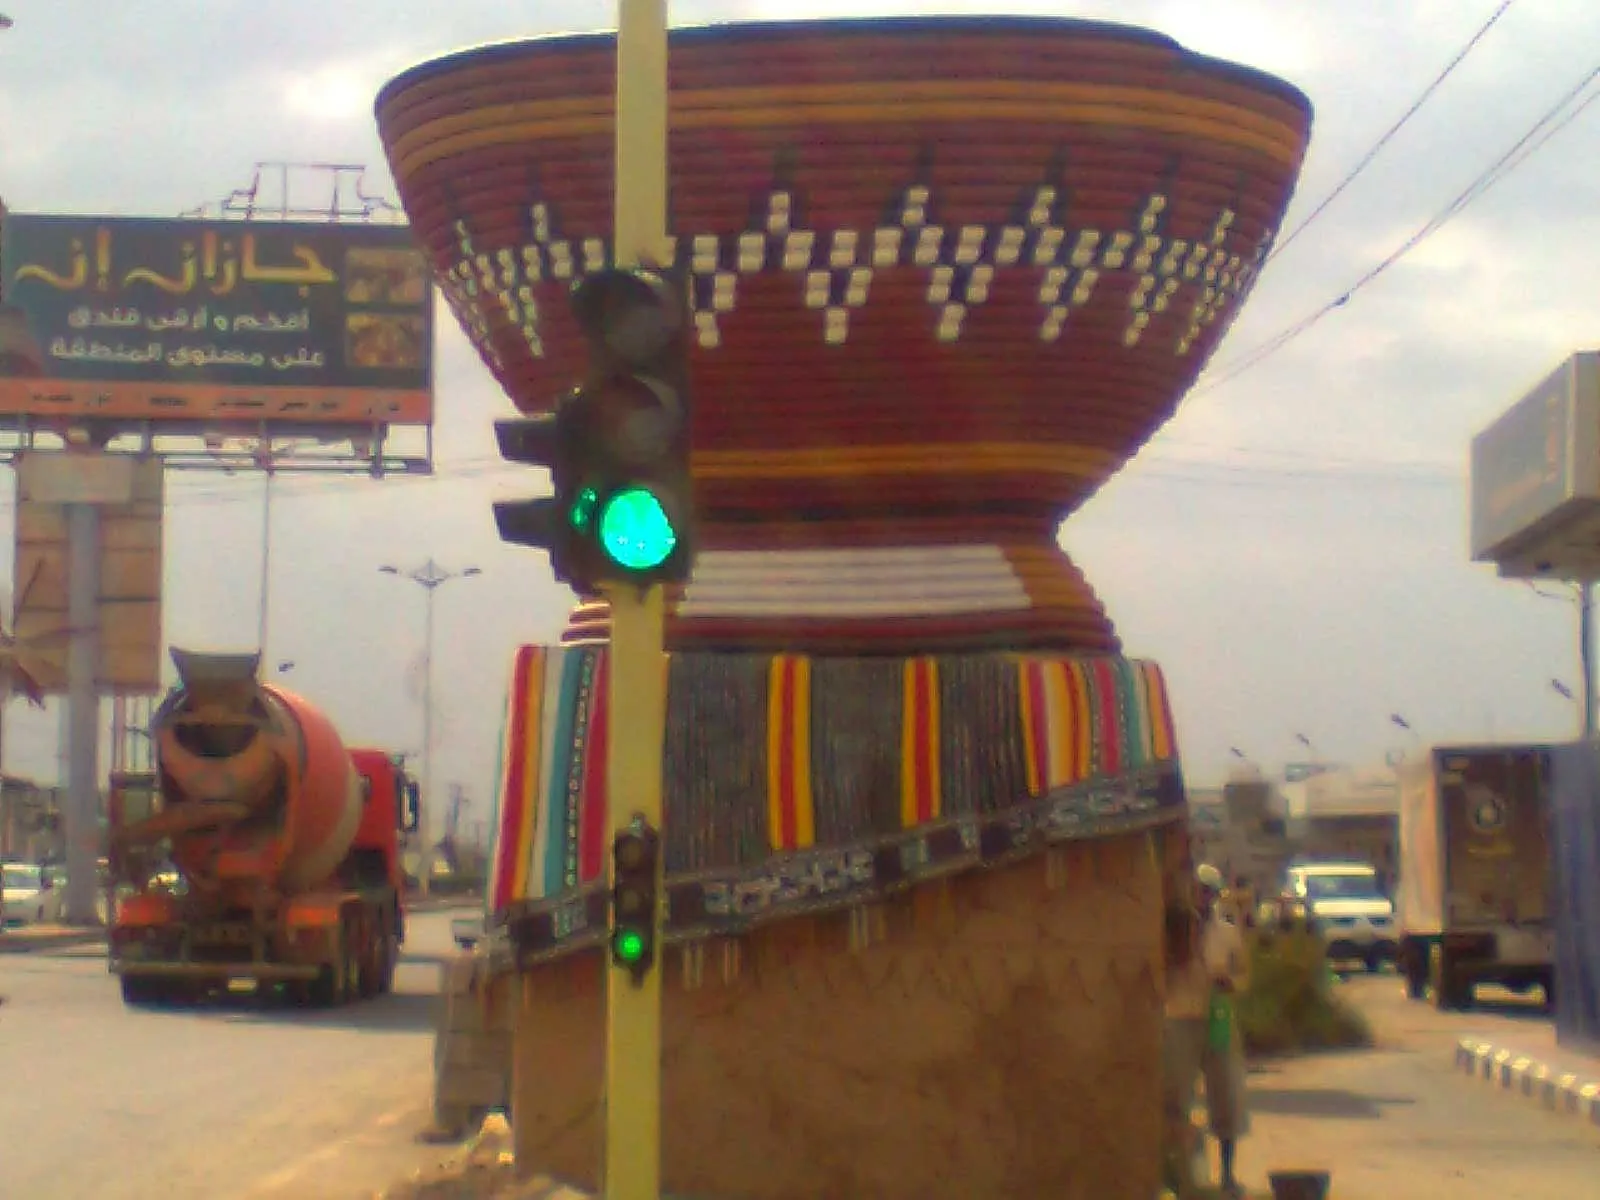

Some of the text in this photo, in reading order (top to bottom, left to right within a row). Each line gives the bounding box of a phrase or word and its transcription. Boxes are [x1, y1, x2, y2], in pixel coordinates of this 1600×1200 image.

[123, 230, 338, 297] جازان
[68, 305, 140, 329] فندق
[50, 335, 162, 363] المنطقة
